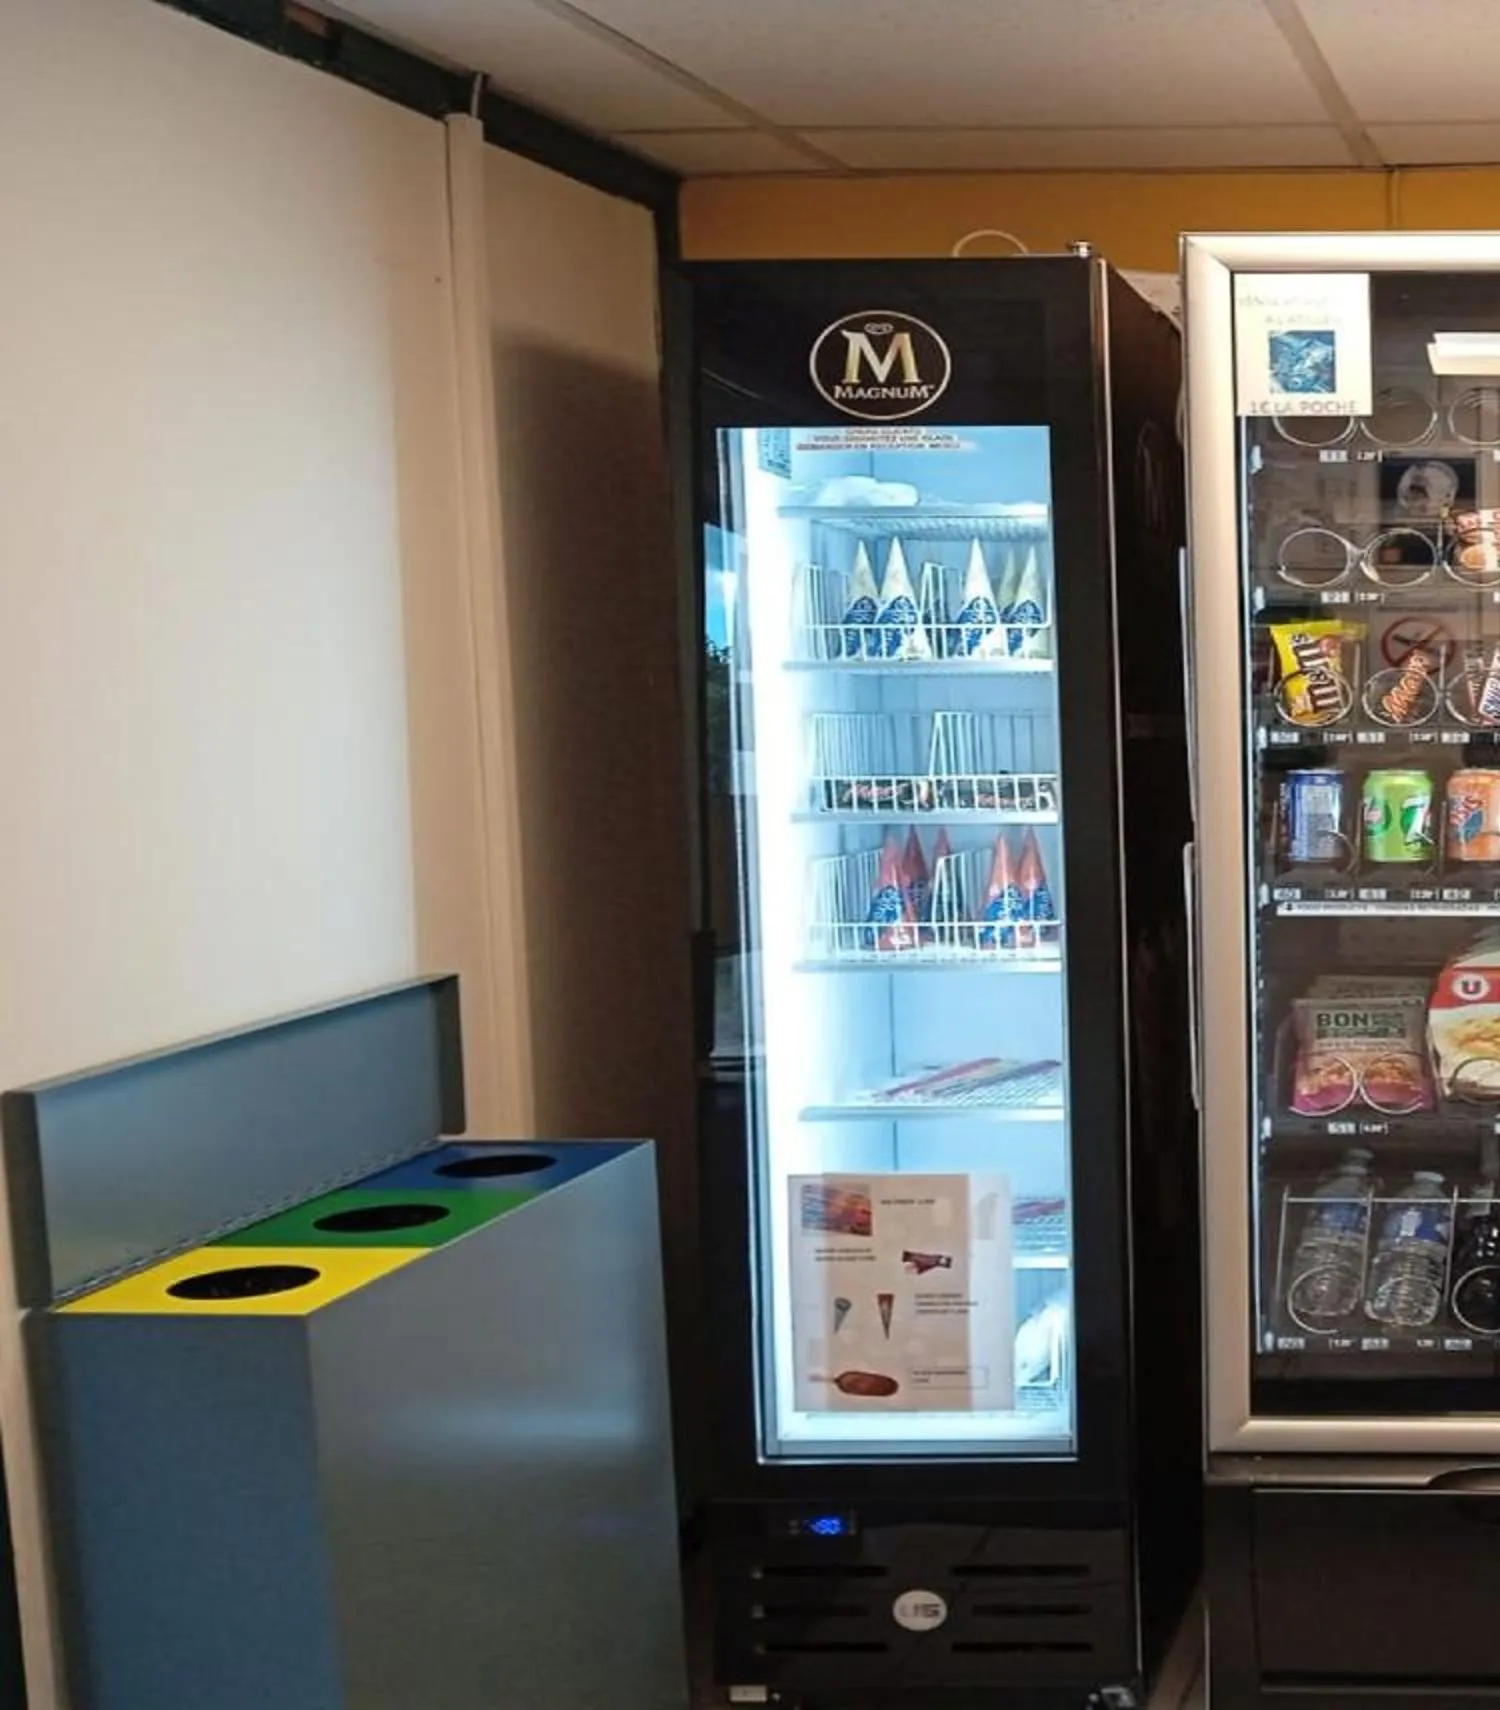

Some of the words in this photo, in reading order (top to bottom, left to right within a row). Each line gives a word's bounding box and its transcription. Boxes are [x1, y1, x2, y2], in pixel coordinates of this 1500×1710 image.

[841, 329, 923, 385] M
[833, 384, 935, 400] MAGNUM
[1299, 400, 1359, 414] POCHE
[1461, 980, 1482, 995] U
[1317, 1013, 1368, 1027] BON
